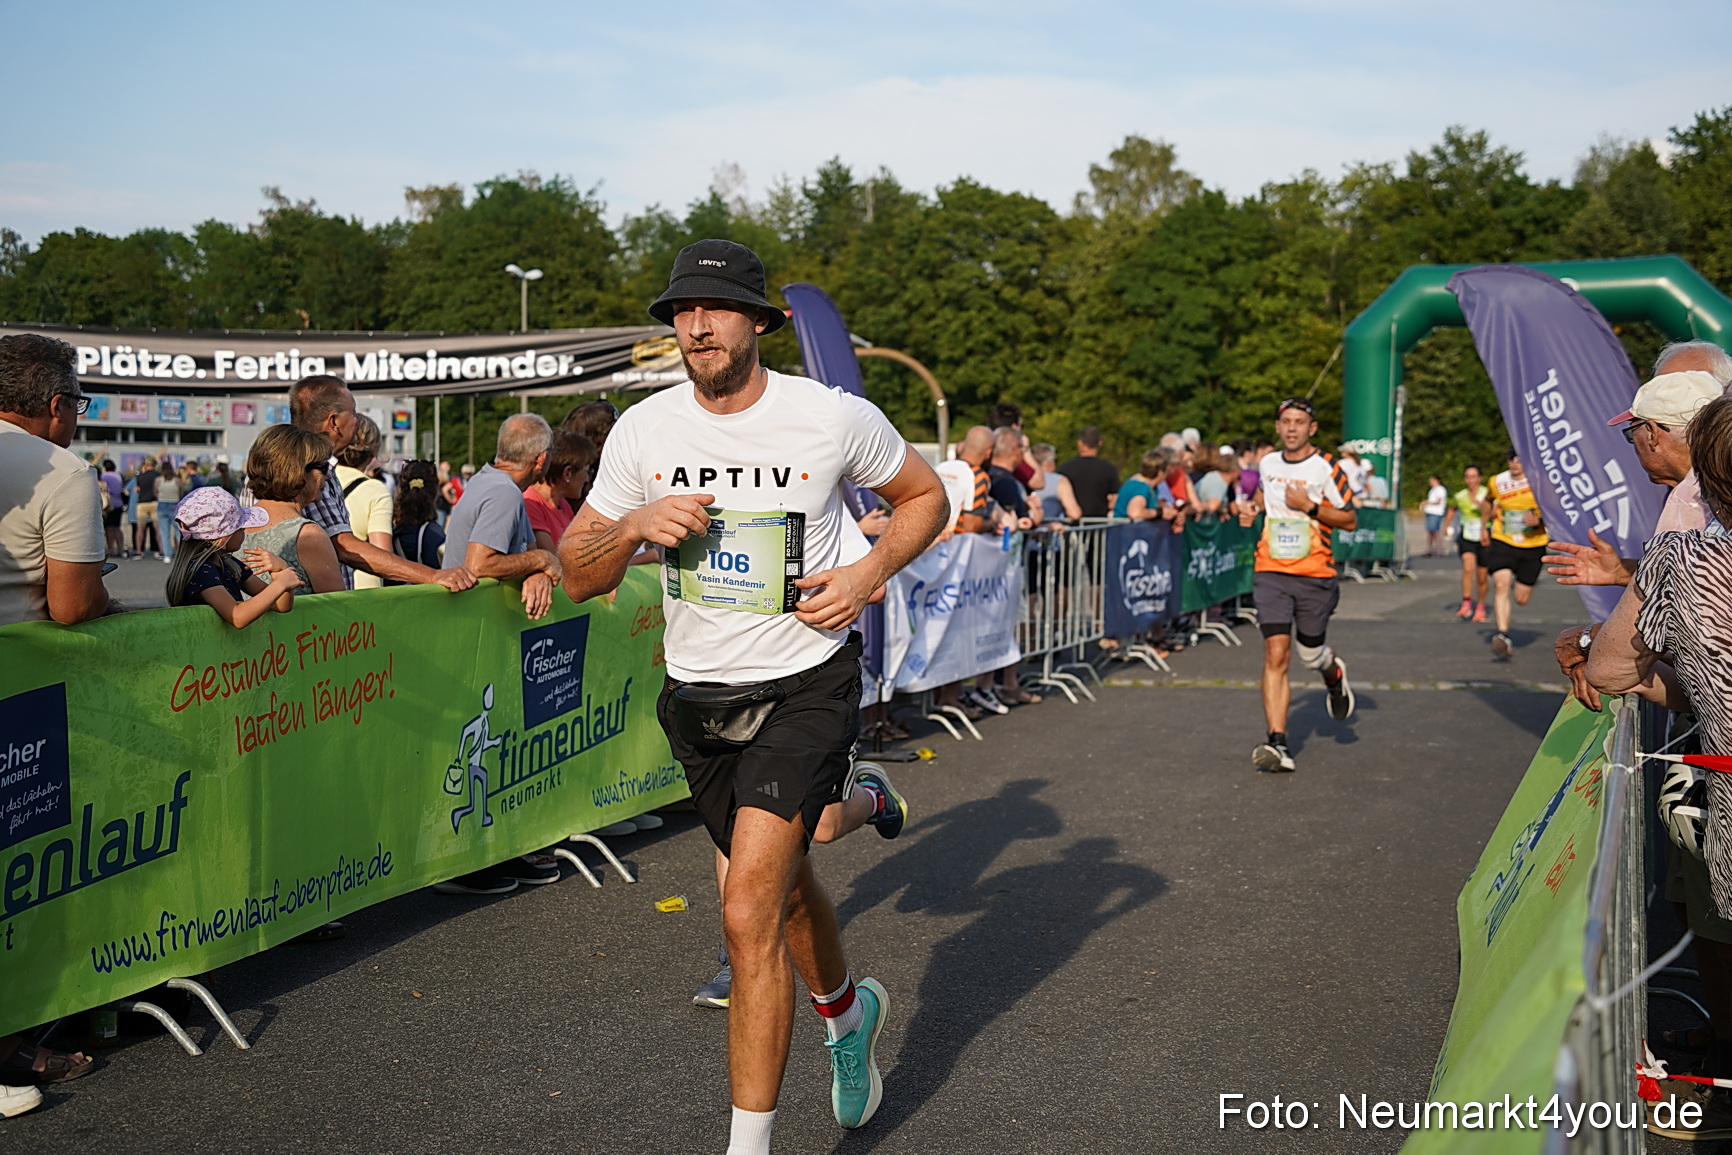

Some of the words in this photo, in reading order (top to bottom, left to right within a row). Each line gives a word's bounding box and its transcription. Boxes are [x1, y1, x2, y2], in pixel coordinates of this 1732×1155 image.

[77, 345, 207, 379] Plätze.
[344, 348, 584, 381] Miteinander.
[670, 466, 792, 488] APTIV
[708, 549, 750, 574] 106
[696, 573, 721, 584] Yasin
[722, 576, 766, 590] Kandemir
[786, 577, 795, 607] HILTL
[170, 631, 290, 713] Gesunde
[296, 621, 377, 671] Firmen
[532, 649, 577, 676] Fischer
[536, 665, 572, 685] AUTOMOBILE
[235, 691, 307, 756] laufen
[312, 652, 396, 725] länger!
[499, 677, 633, 788] firmenlauf
[6, 797, 22, 813] das
[35, 795, 60, 815] mit!
[500, 767, 562, 815] neumarkt
[91, 841, 395, 974] www.firmenlauf-oberpfalz.de
